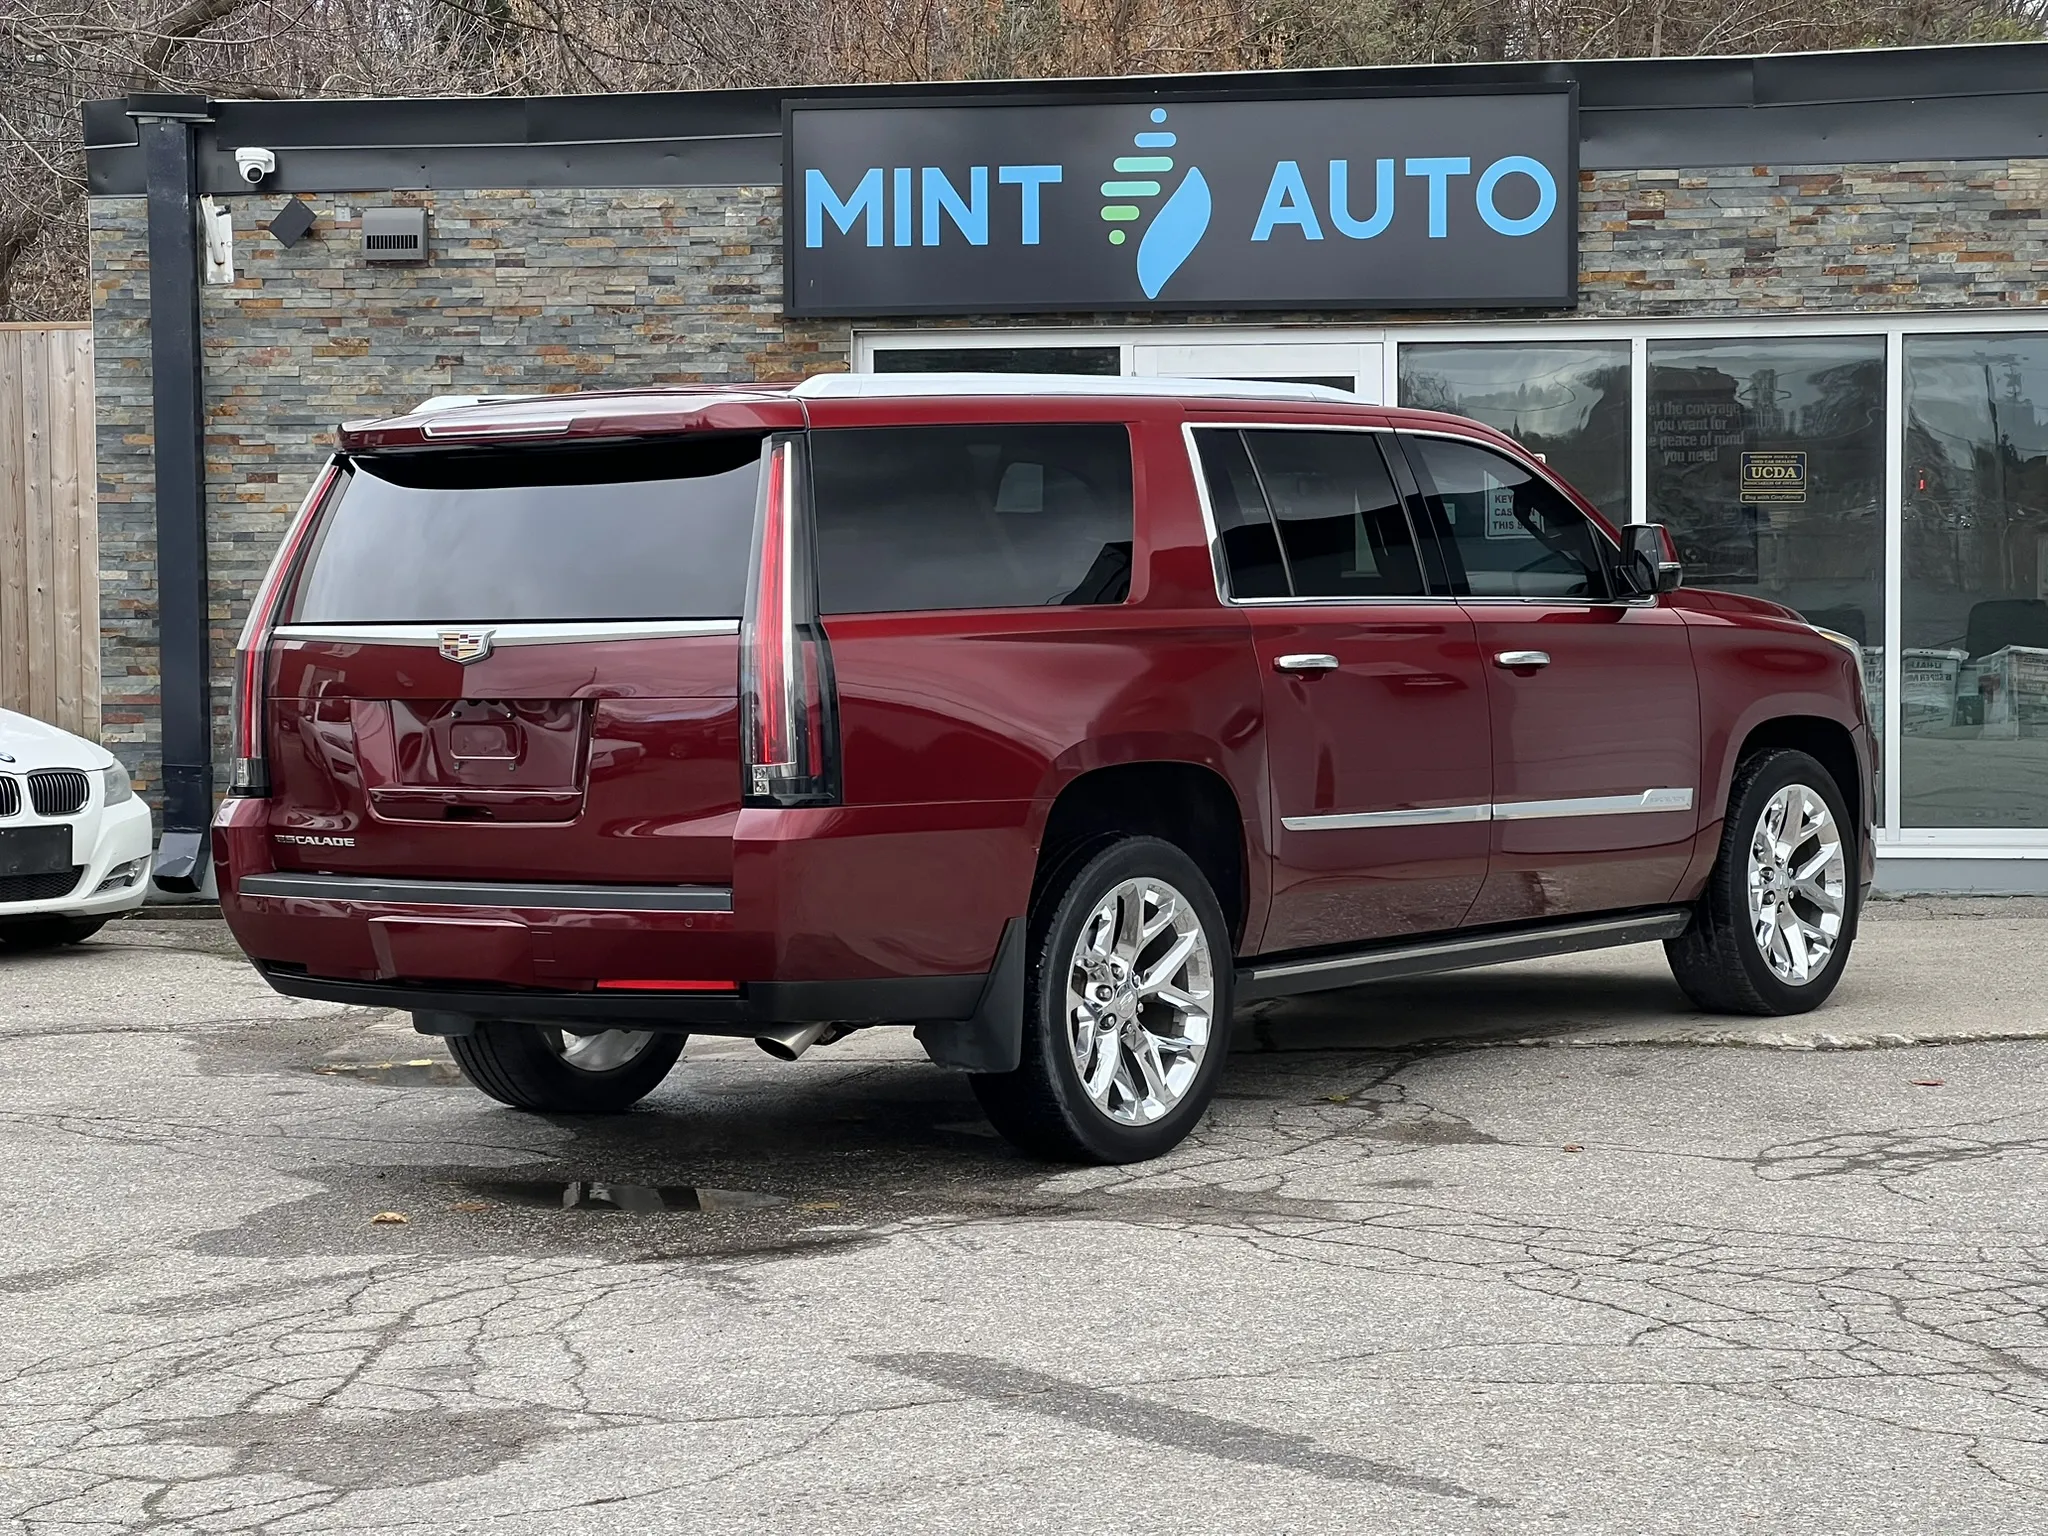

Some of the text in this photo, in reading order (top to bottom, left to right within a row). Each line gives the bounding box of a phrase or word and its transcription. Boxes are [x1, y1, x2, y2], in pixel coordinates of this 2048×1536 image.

[804, 155, 1558, 249] MINT AUTO
[1663, 401, 1683, 415] the
[1685, 402, 1740, 417] coverage
[1653, 415, 1728, 434] you want for
[1660, 435, 1697, 450] peace
[1700, 431, 1713, 446] of
[1715, 430, 1744, 445] mind
[1663, 446, 1719, 466] you need
[1751, 466, 1797, 478] UCDA
[1494, 494, 1514, 504] KEY
[1494, 508, 1513, 517] CAS
[1492, 521, 1514, 530] THIS
[274, 834, 356, 847] ESCALADE
